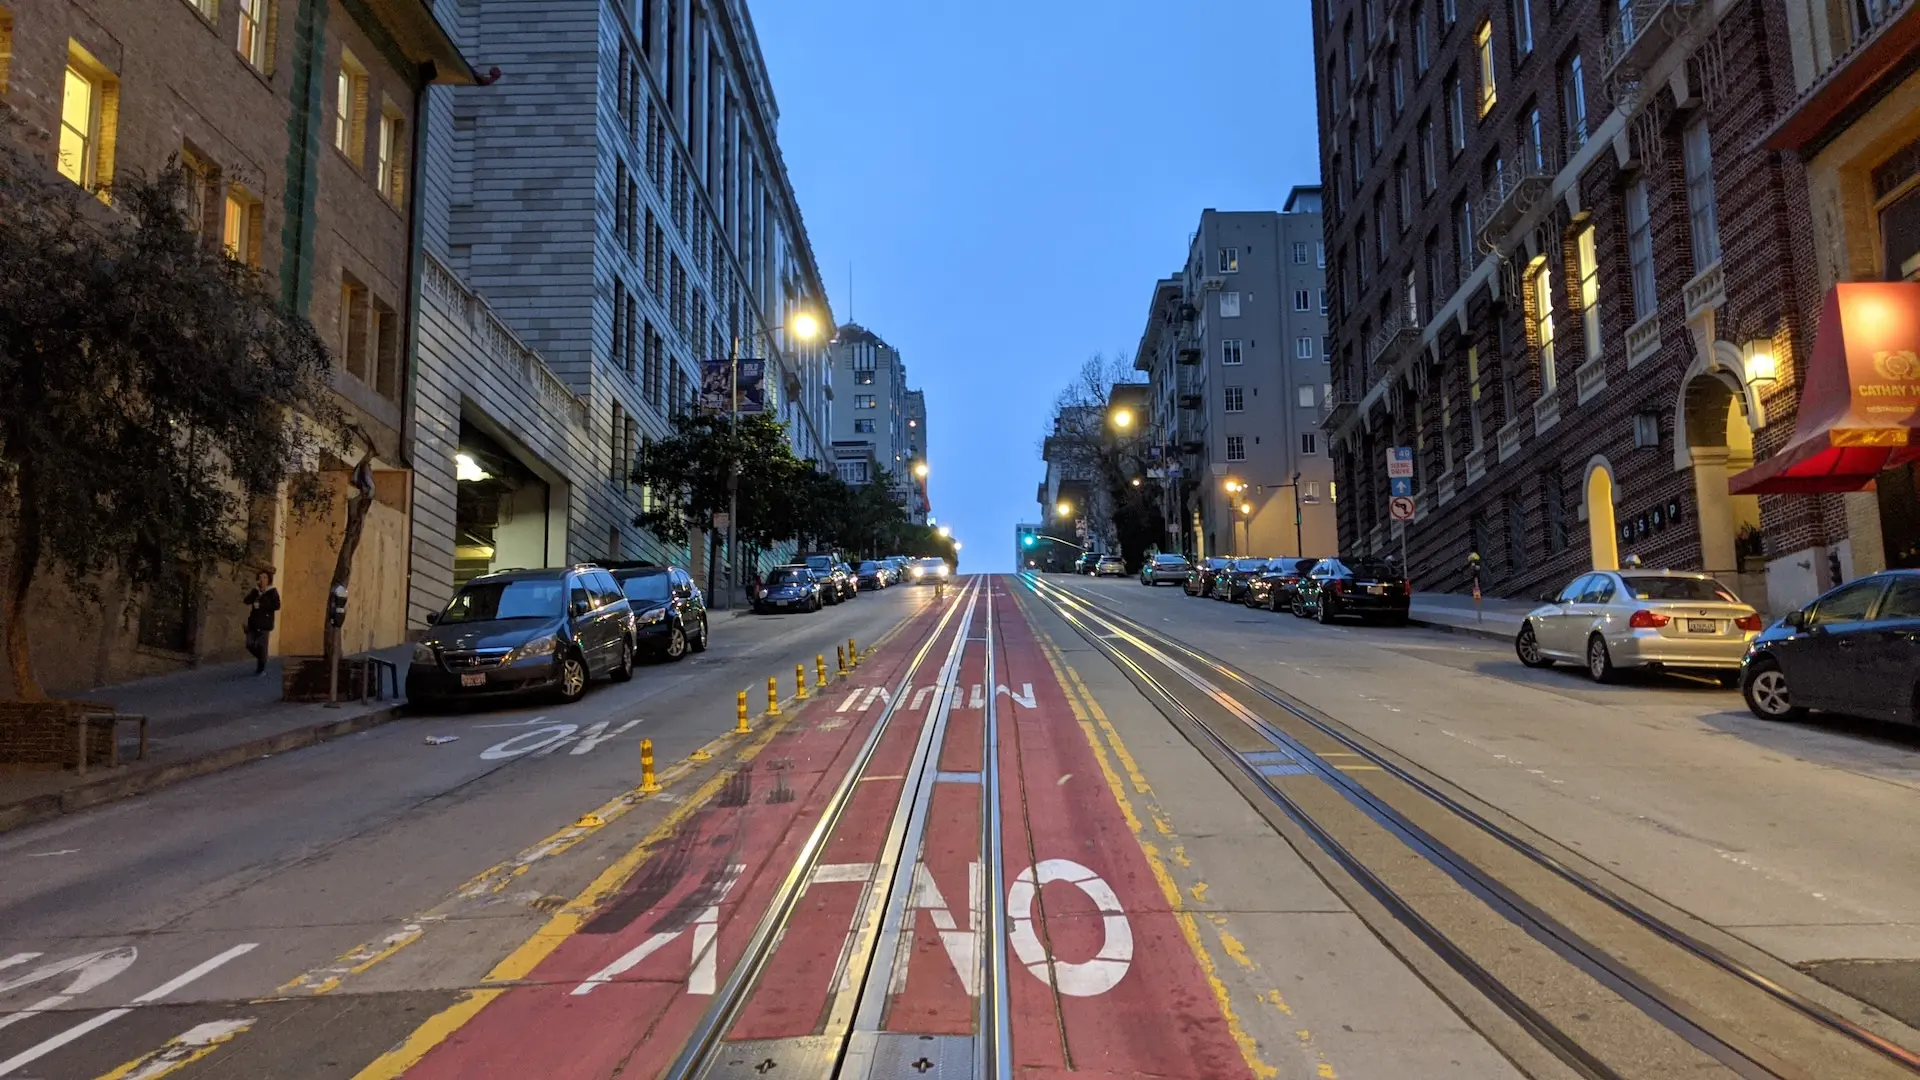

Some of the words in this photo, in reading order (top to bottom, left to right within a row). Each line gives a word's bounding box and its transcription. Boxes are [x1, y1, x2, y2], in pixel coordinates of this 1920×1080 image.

[1858, 384, 1906, 396] CATHAY
[836, 682, 1038, 713] MUNI
[570, 858, 1133, 998] ONLY
